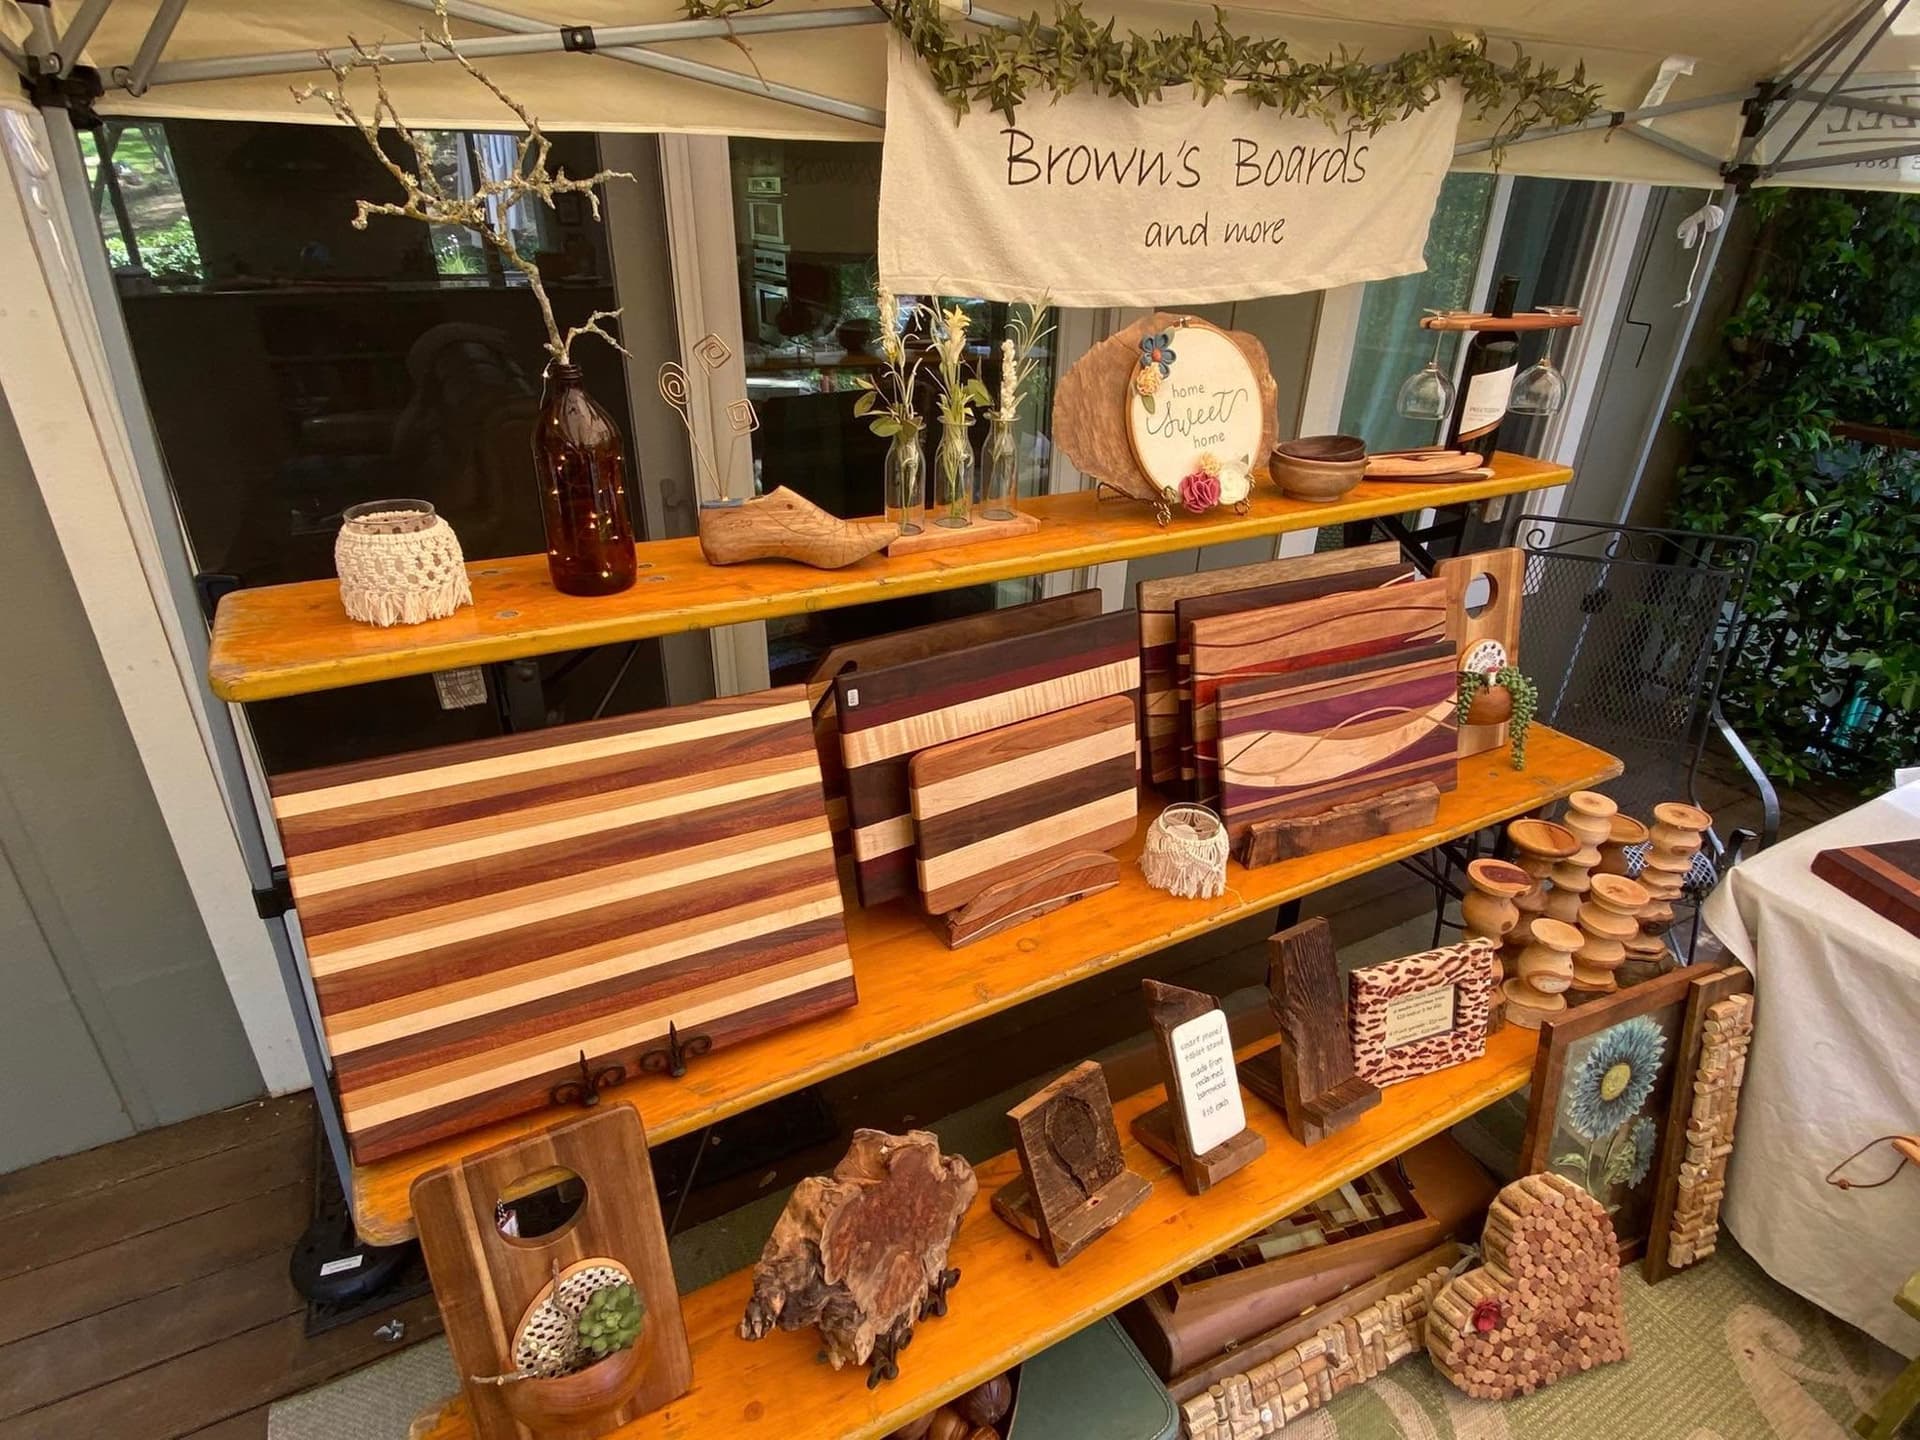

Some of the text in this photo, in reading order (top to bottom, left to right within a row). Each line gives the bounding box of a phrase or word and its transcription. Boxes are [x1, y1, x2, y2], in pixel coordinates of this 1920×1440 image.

[1000, 128, 1369, 188] Brown's Boards
[1144, 211, 1286, 247] and more
[1172, 384, 1205, 398] home
[1193, 432, 1225, 448] home
